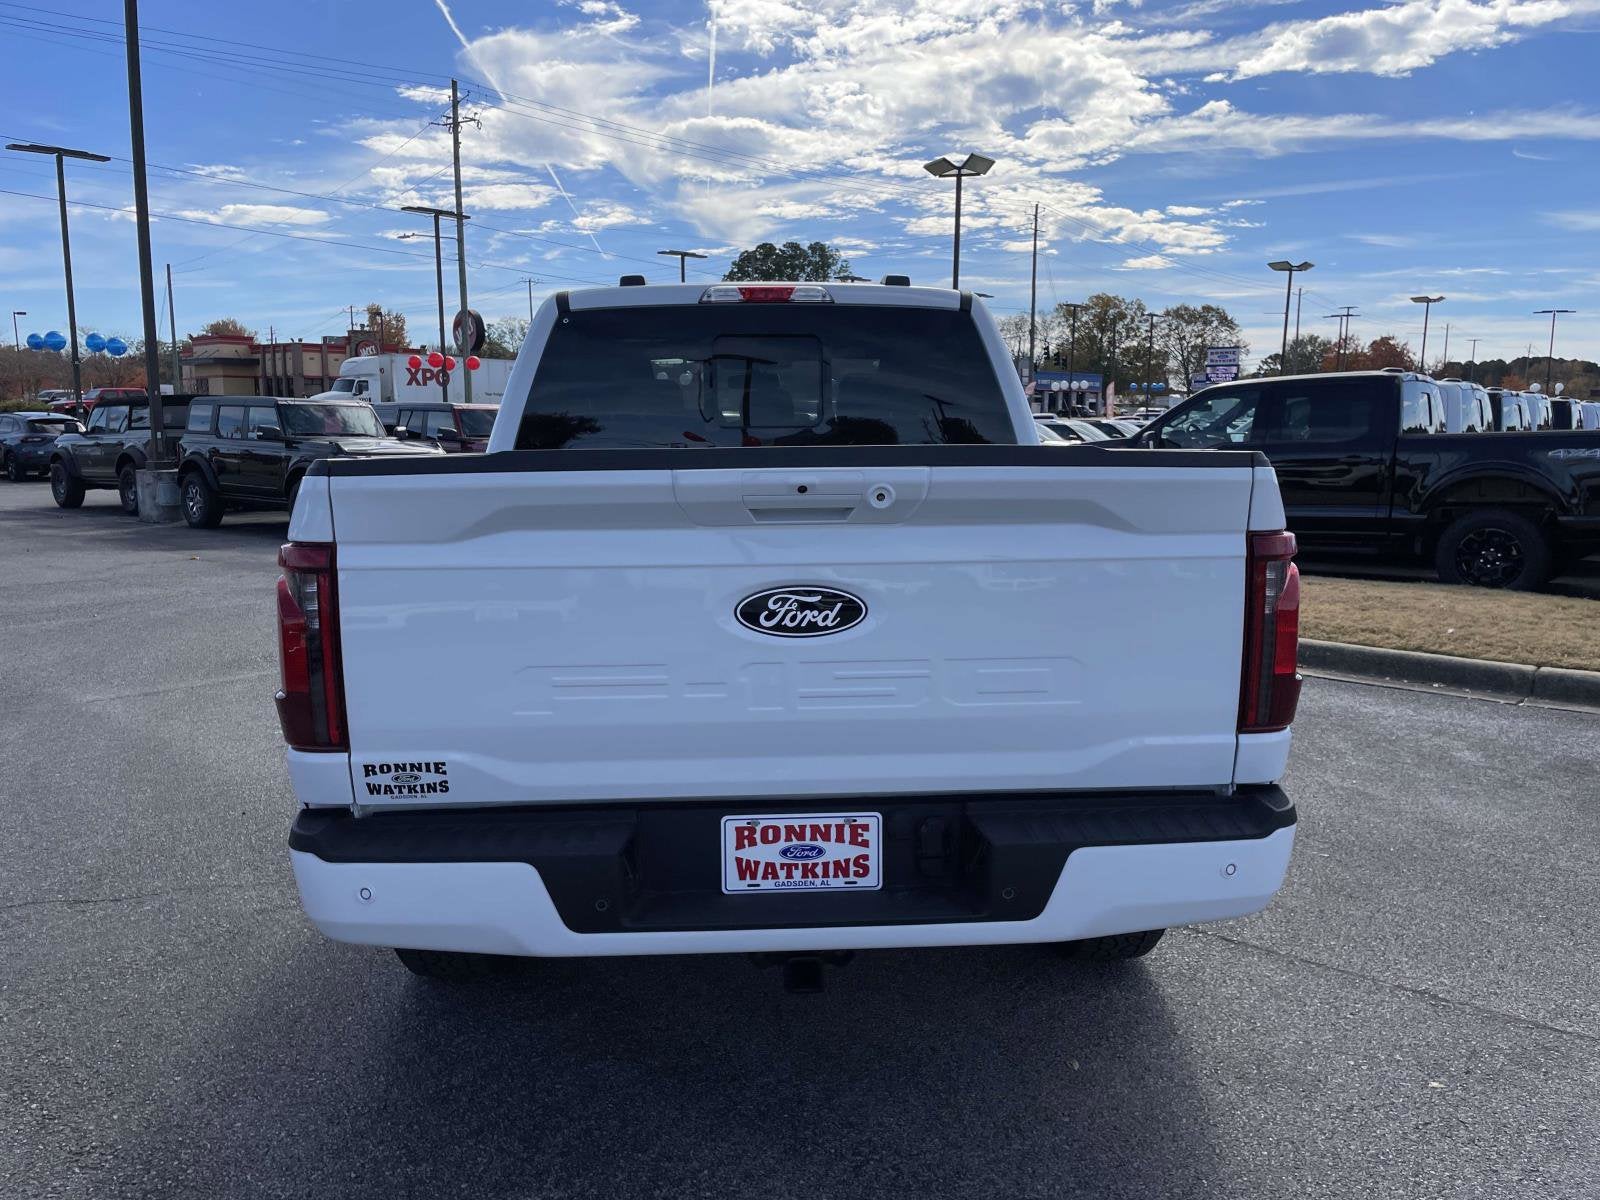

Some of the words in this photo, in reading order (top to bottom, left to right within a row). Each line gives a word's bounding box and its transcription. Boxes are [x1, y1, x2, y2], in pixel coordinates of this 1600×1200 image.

[406, 368, 450, 387] XPO
[760, 594, 843, 627] Ford
[512, 655, 1086, 716] F-150
[363, 762, 447, 777] RONNIE
[366, 780, 449, 795] WATKINS
[735, 824, 870, 851] RONNIE
[787, 846, 819, 857] Ford
[735, 853, 870, 881] WATKINS
[774, 880, 818, 888] GADSDEN,
